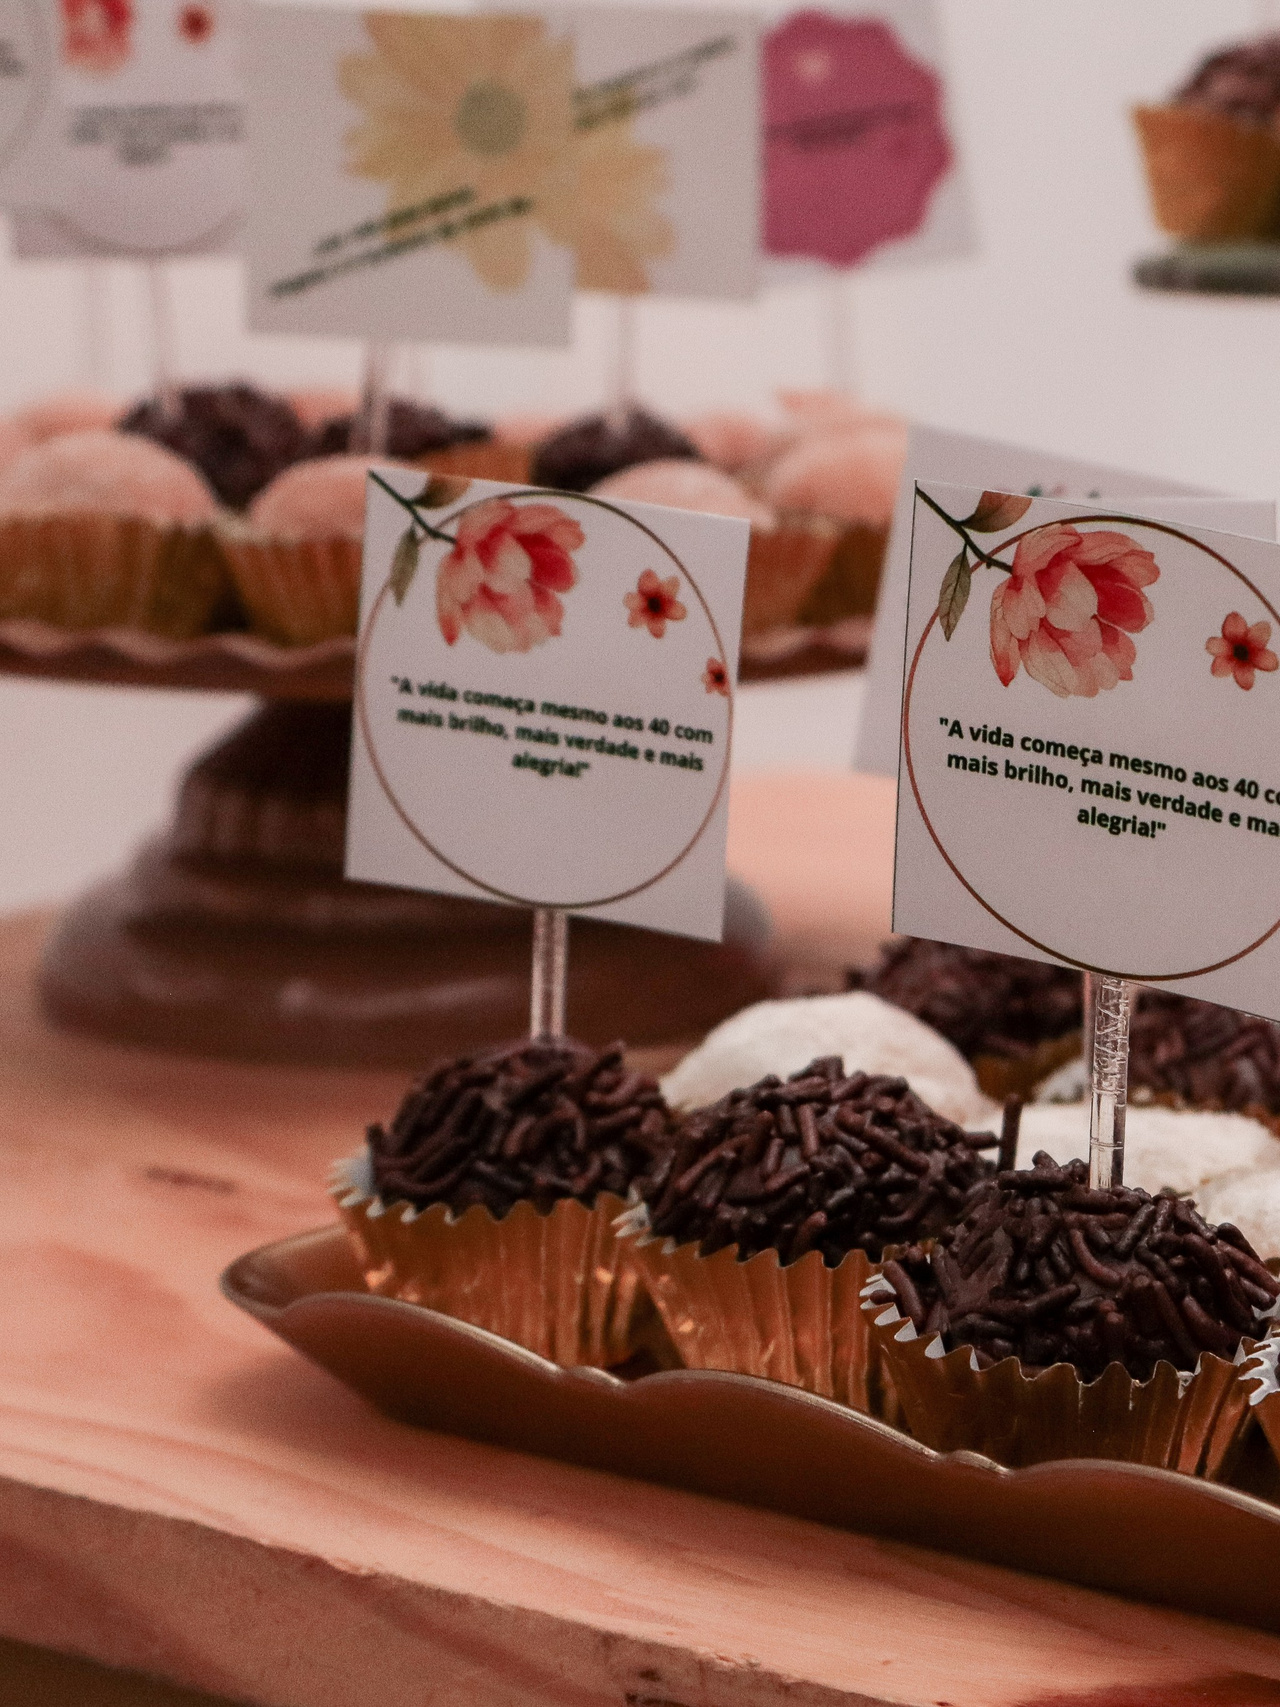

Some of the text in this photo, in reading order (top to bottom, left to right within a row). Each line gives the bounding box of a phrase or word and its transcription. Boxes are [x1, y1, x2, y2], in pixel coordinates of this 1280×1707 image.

[391, 676, 713, 744] "A vida começa mesmo aos 40 com
[397, 708, 704, 771] mais brilho, mais verdade e mais
[939, 717, 963, 739] "A
[969, 724, 1014, 748] vida
[1020, 736, 1103, 767] começa
[1109, 751, 1187, 783] mesmo
[1193, 769, 1229, 793] aos
[1234, 778, 1259, 799] 40
[947, 751, 998, 777] mais
[1004, 759, 1074, 793] brilho,
[1081, 775, 1131, 802] mais
[1137, 788, 1223, 822] verdade
[1228, 809, 1241, 827] e
[1077, 806, 1167, 839] alegria!"
